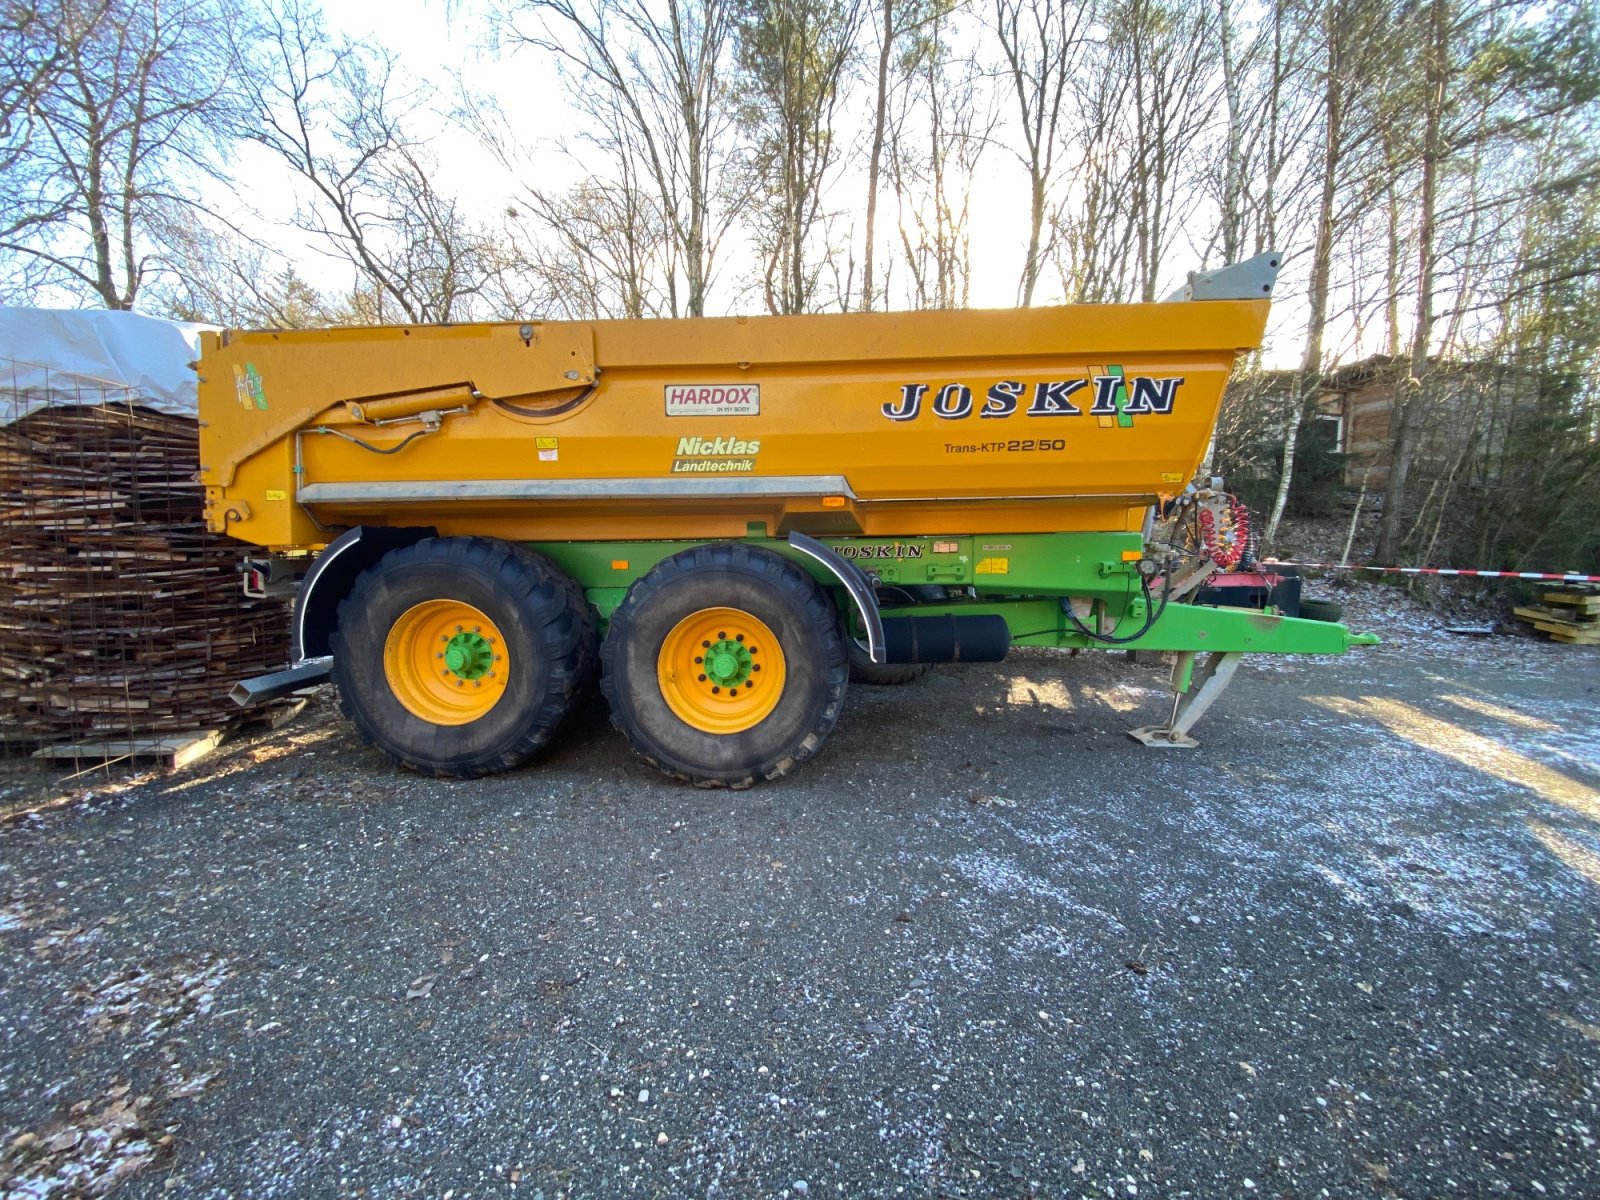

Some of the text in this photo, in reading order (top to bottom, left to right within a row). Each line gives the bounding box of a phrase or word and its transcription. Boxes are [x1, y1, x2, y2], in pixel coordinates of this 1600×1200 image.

[670, 388, 752, 405] HARDOX
[881, 375, 1184, 422] JOSKIN
[676, 436, 760, 455] Nicklas
[944, 439, 1066, 453] Trans-KTP 22/50
[674, 460, 752, 472] Landtechnik
